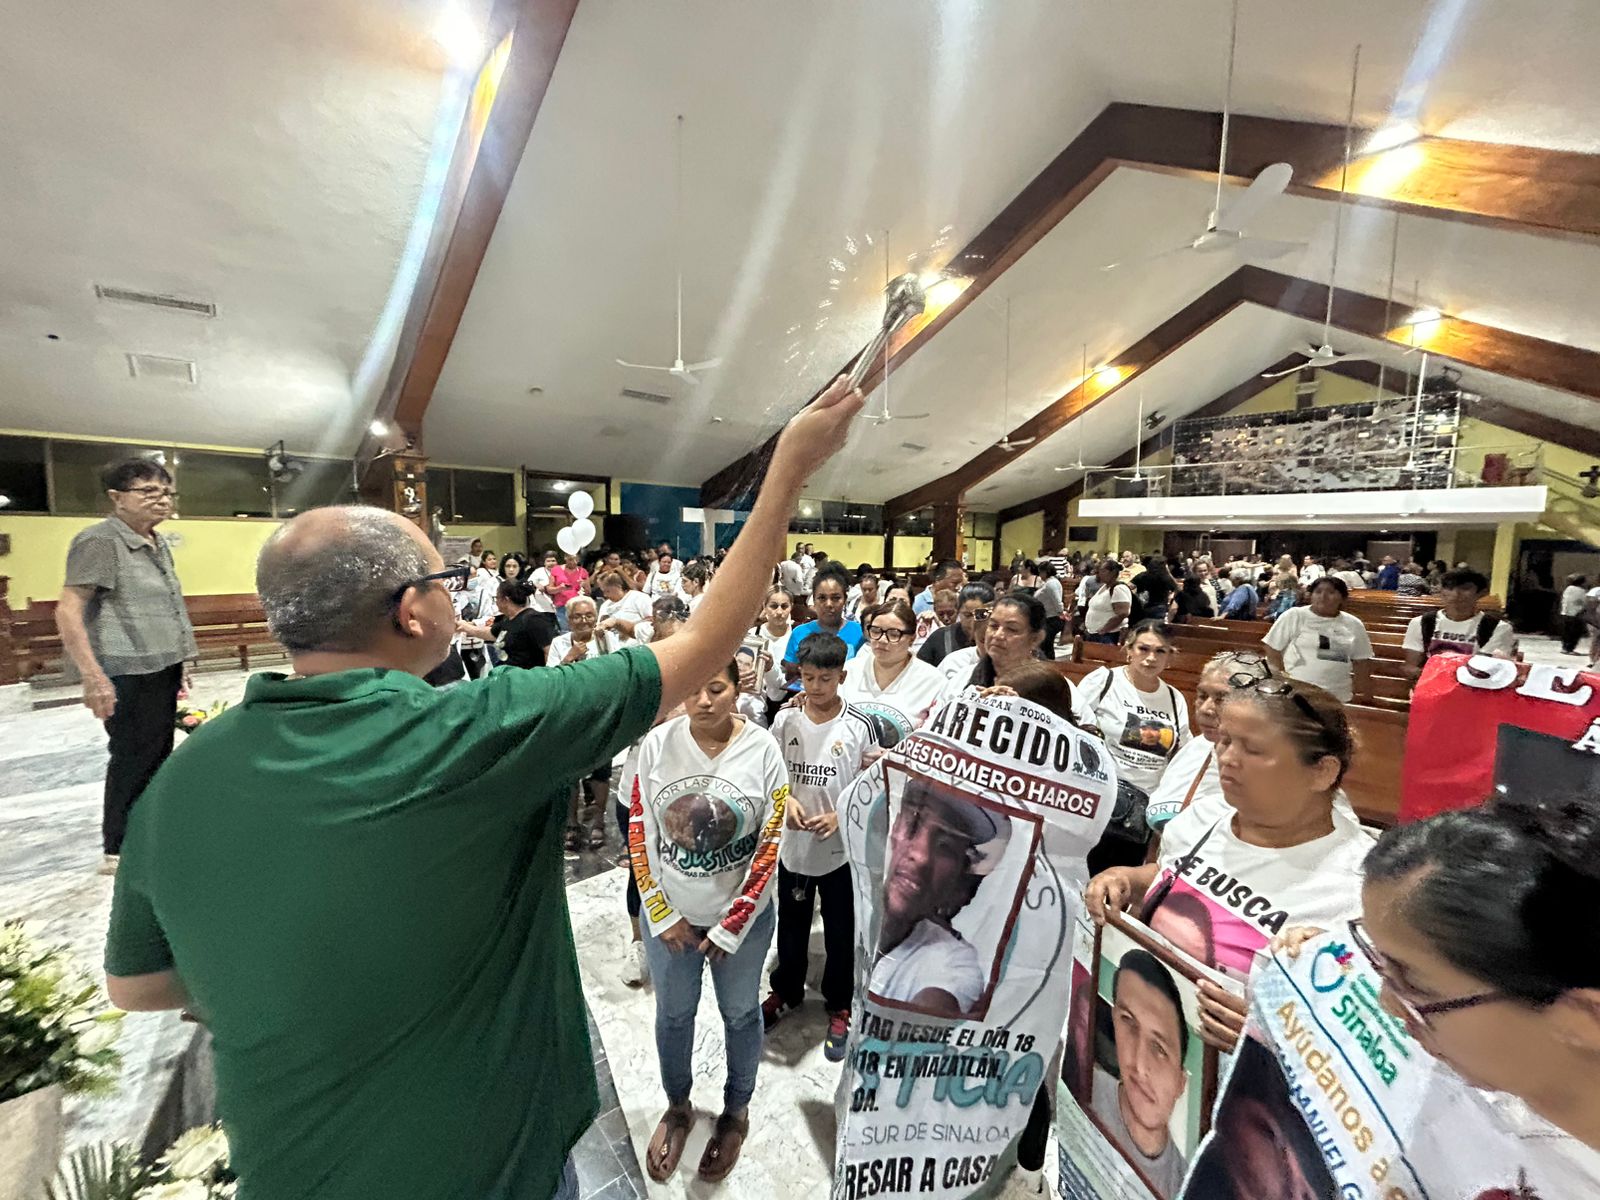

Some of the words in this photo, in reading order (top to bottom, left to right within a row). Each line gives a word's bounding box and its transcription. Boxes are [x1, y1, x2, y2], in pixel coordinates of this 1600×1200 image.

[860, 703, 879, 711] LAS
[882, 706, 911, 733] VOCES
[1019, 706, 1052, 725] TODOS
[930, 701, 1070, 773] ARECIDO
[656, 784, 681, 808] POR
[684, 777, 710, 789] LAS
[714, 780, 751, 813] VOCES
[801, 774, 828, 787] BETTER
[850, 763, 884, 831] POR
[930, 748, 1026, 796] ROMERO
[1027, 781, 1095, 816] HAROS
[1146, 804, 1168, 816] OR
[1196, 866, 1289, 936] BUSCA
[897, 1020, 952, 1045] DESDE
[957, 1029, 975, 1047] EL
[980, 1025, 1010, 1049] DÍA
[1015, 1034, 1036, 1053] 18
[1331, 993, 1398, 1086] Sinaloa
[883, 1055, 905, 1079] EN
[1276, 1000, 1374, 1153] Ayúdanos
[1370, 1157, 1389, 1182] a
[862, 1125, 899, 1146] SUR
[905, 1122, 929, 1141] DE
[931, 1122, 1010, 1145] SINALOA
[845, 1157, 915, 1200] RESAR
[919, 1157, 936, 1193] A
[942, 1153, 999, 1190] CASA
